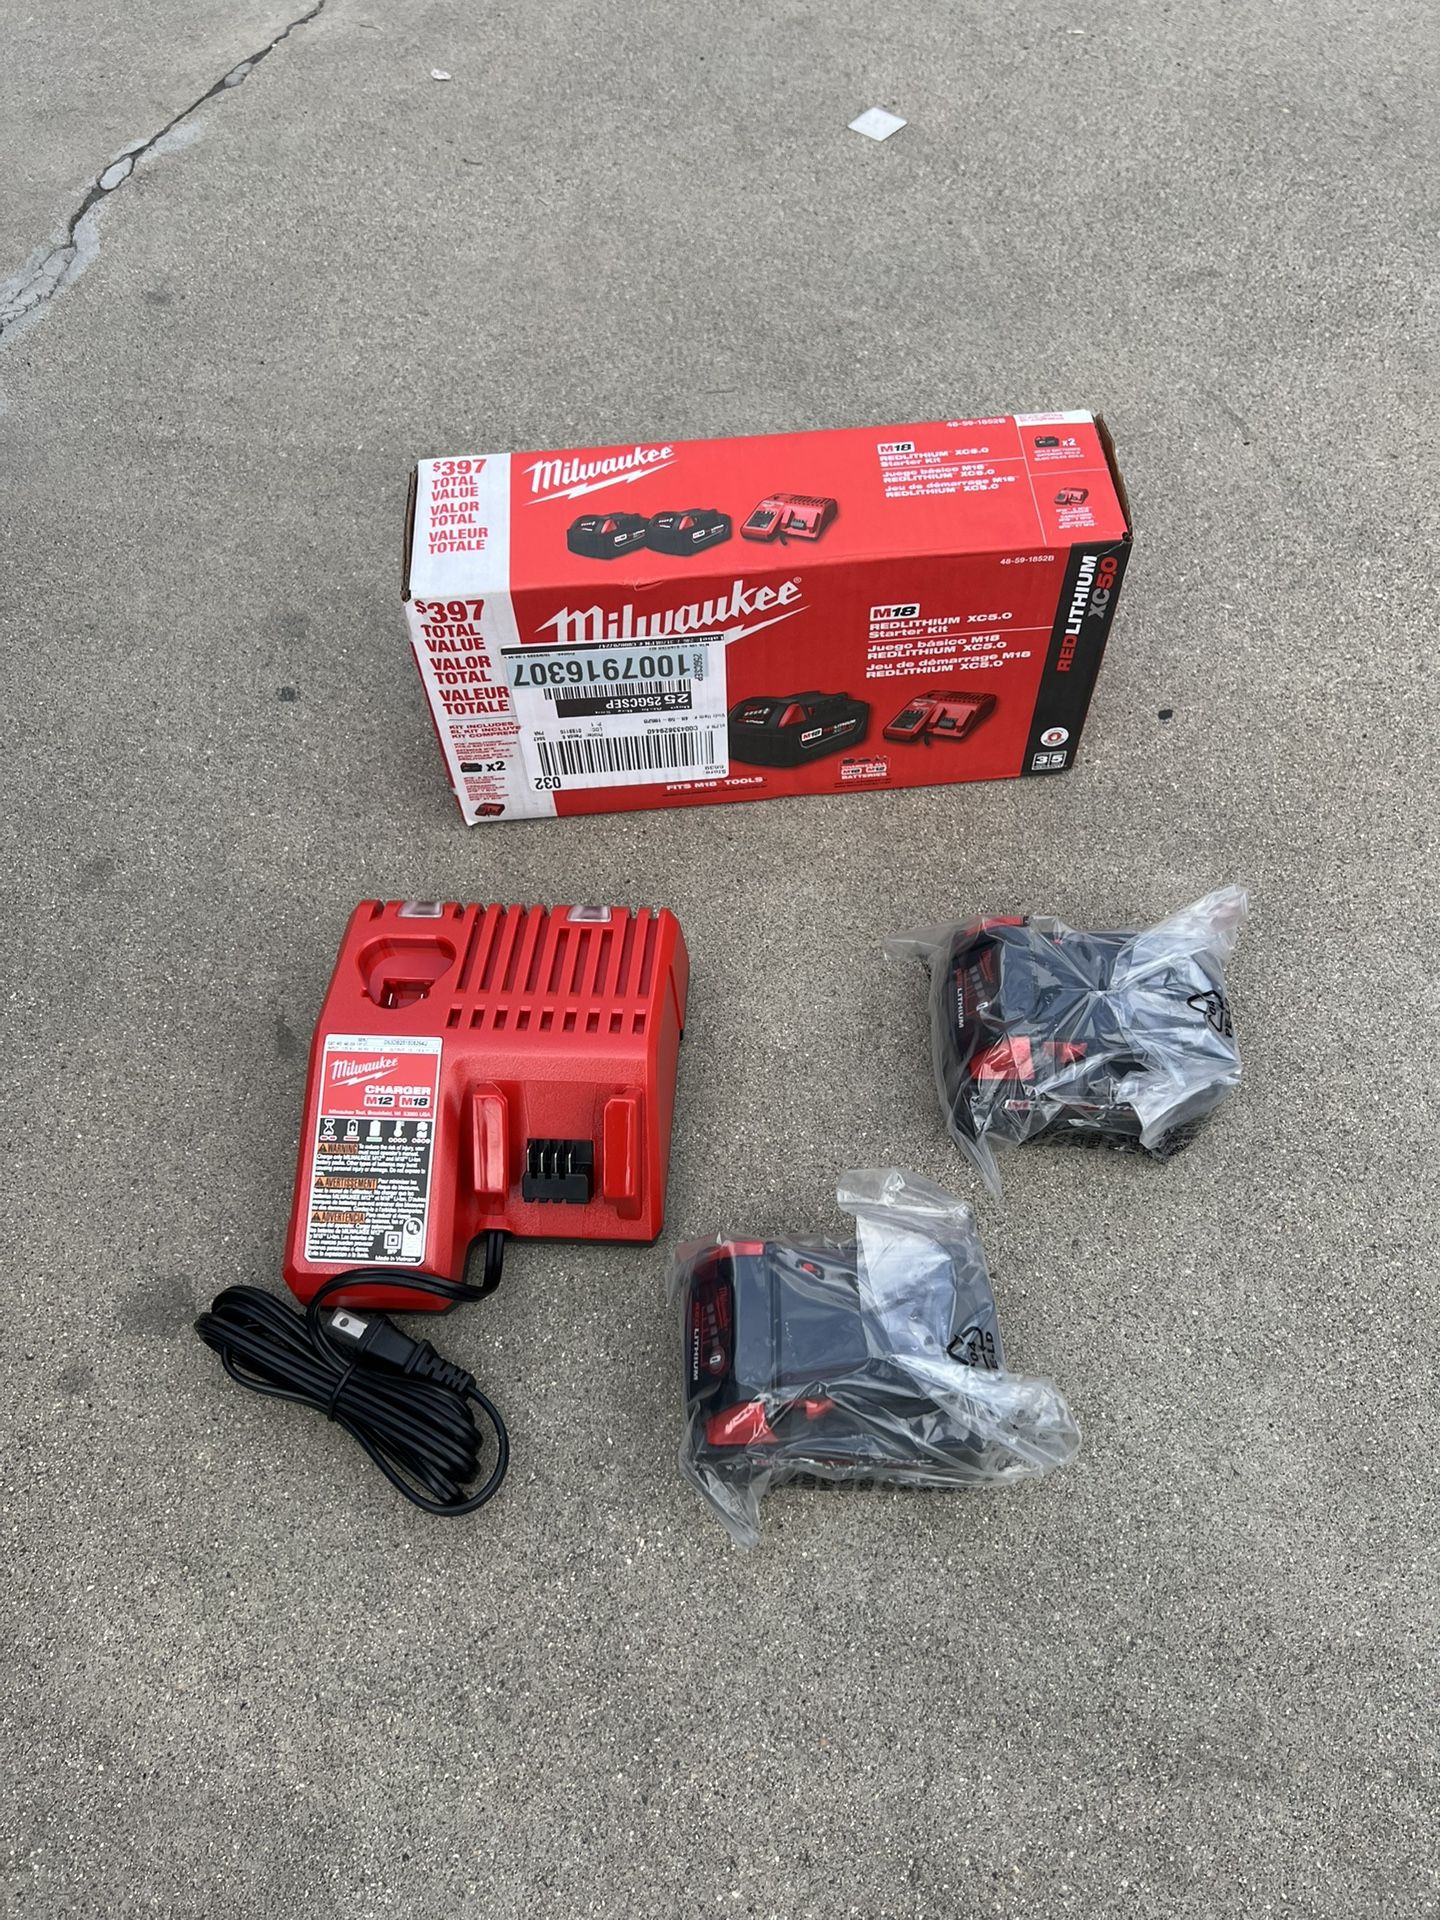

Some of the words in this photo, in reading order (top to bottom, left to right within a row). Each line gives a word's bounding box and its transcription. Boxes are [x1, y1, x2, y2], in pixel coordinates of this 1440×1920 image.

[879, 443, 913, 453] M18
[1062, 437, 1077, 446] x2
[433, 459, 487, 476] $397
[523, 446, 673, 494] Milwaukee
[880, 459, 922, 468] Starter
[882, 470, 918, 478] Juego
[432, 475, 477, 490] TOTAL
[431, 487, 479, 501] VALUE
[431, 501, 480, 516] VALOR
[430, 514, 477, 527] TOTAL
[428, 527, 488, 542] VALEUR
[428, 539, 486, 554] TOTALE
[1000, 555, 1054, 566] 48-59-1852B
[415, 600, 485, 624] $397
[872, 605, 918, 618] M18
[1056, 555, 1098, 673] REDLITHIUM
[869, 616, 960, 631] REDLITHIUM
[966, 612, 1013, 623] XC5.0
[420, 624, 481, 638] TOTAL
[868, 628, 923, 639] Starter
[927, 625, 949, 634] Kit
[424, 638, 485, 653] VALUE
[867, 642, 914, 653] Juego
[917, 637, 967, 648] básico
[970, 634, 1001, 644] M18
[867, 646, 956, 660] REDLITHIUM
[962, 641, 1008, 652] XC5.0
[429, 656, 492, 671] VALOR
[866, 662, 893, 671] Jeu
[896, 659, 915, 668] de
[918, 653, 999, 667] démarrage
[1001, 650, 1032, 659] M18
[514, 654, 690, 686] 1007916307
[866, 664, 954, 678] REDLITHIUM
[959, 660, 1004, 670] XC5.0
[434, 672, 491, 685] TOTAL
[439, 687, 510, 702] VALEUR
[664, 693, 689, 704] 25
[443, 700, 510, 715] TOTALE
[606, 696, 662, 709] 25GCSEP
[486, 761, 506, 772] x2
[534, 776, 561, 790] 032
[665, 783, 693, 791] FITS
[724, 776, 763, 786] TOOLS
[330, 1056, 398, 1080] Milwaukee
[365, 1085, 432, 1095] CHARGER
[365, 1095, 393, 1105] M12
[401, 1097, 428, 1107] M18
